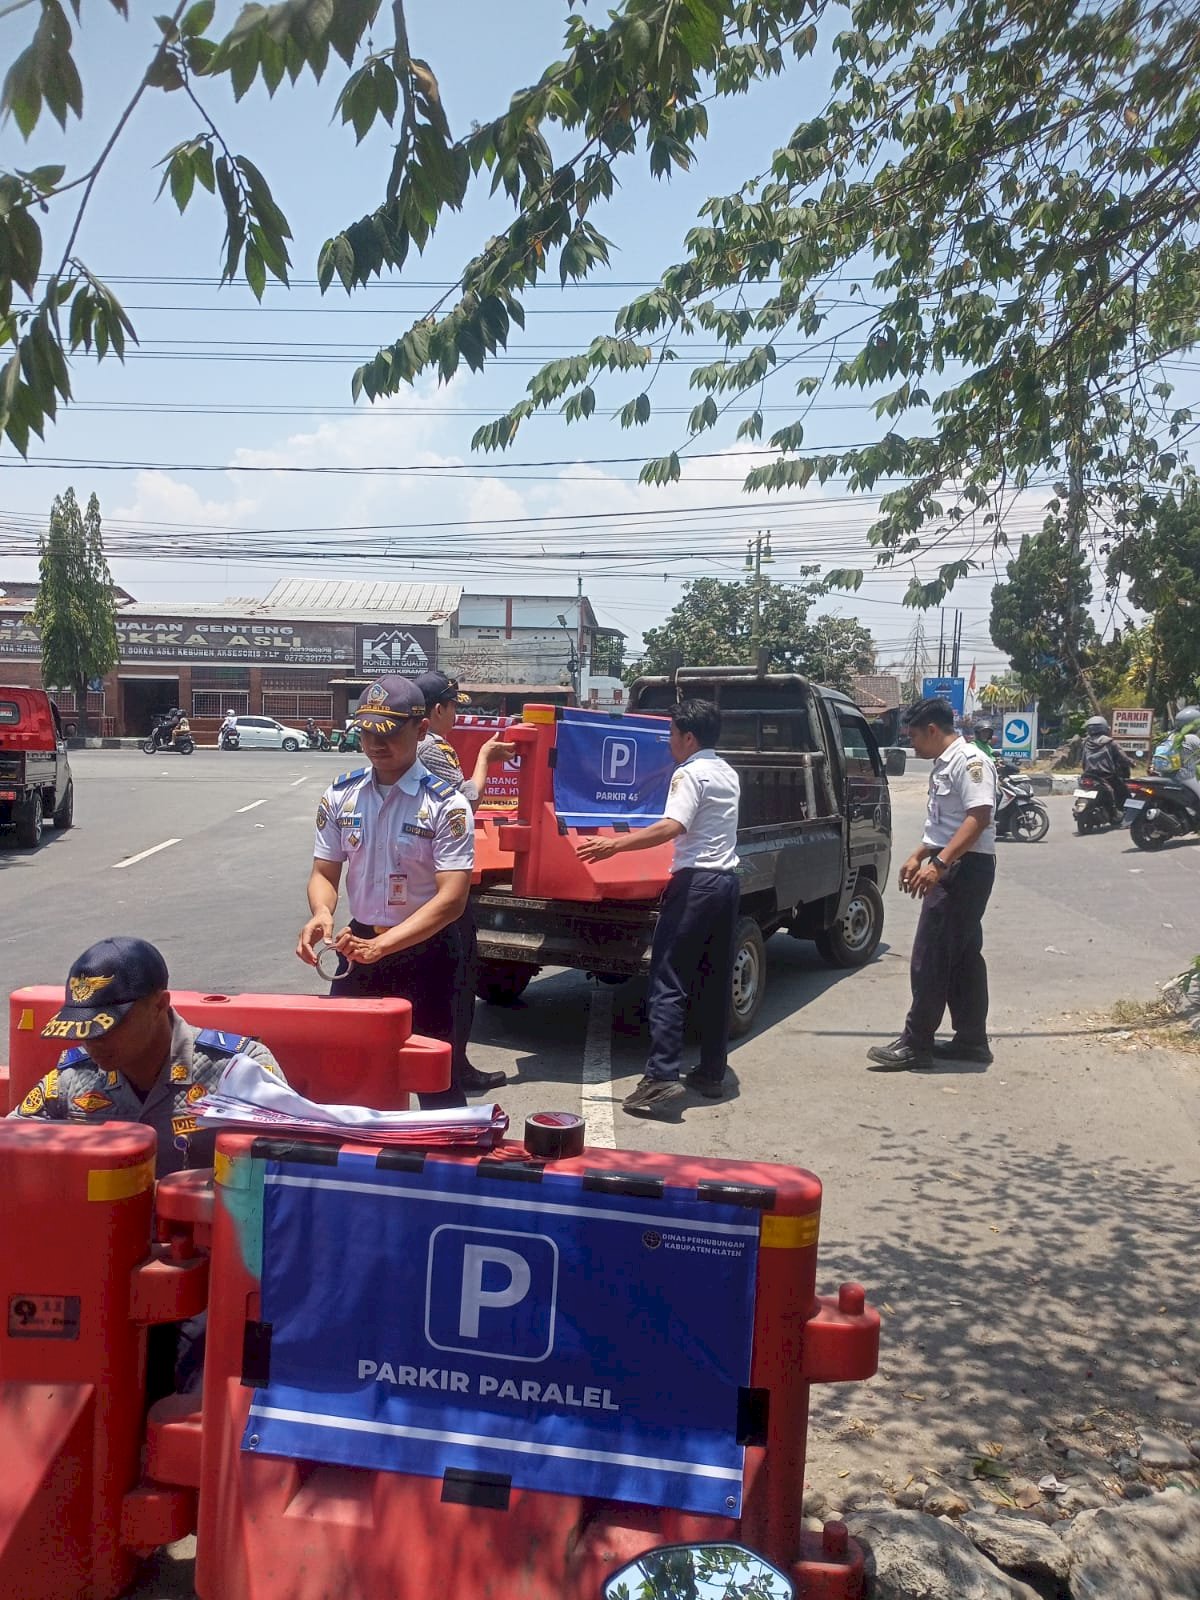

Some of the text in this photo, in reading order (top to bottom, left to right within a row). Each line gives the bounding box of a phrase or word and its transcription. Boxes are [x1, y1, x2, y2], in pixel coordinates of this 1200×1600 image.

[113, 622, 183, 632] UALAN
[195, 624, 294, 635] GENTENG
[116, 632, 208, 646] OKKA
[226, 635, 302, 647] ASLI
[362, 637, 429, 661] KIA
[1116, 712, 1149, 721] PARKIR
[610, 742, 630, 779] P
[485, 776, 519, 786] ARANG
[595, 791, 627, 801] PARKIR
[662, 1233, 745, 1248] DINAS PERHUBUNGAN
[664, 1243, 742, 1257] KABUPATEN KLATEN
[458, 1243, 532, 1339] P
[357, 1359, 620, 1411] PARKIR PARALEL
